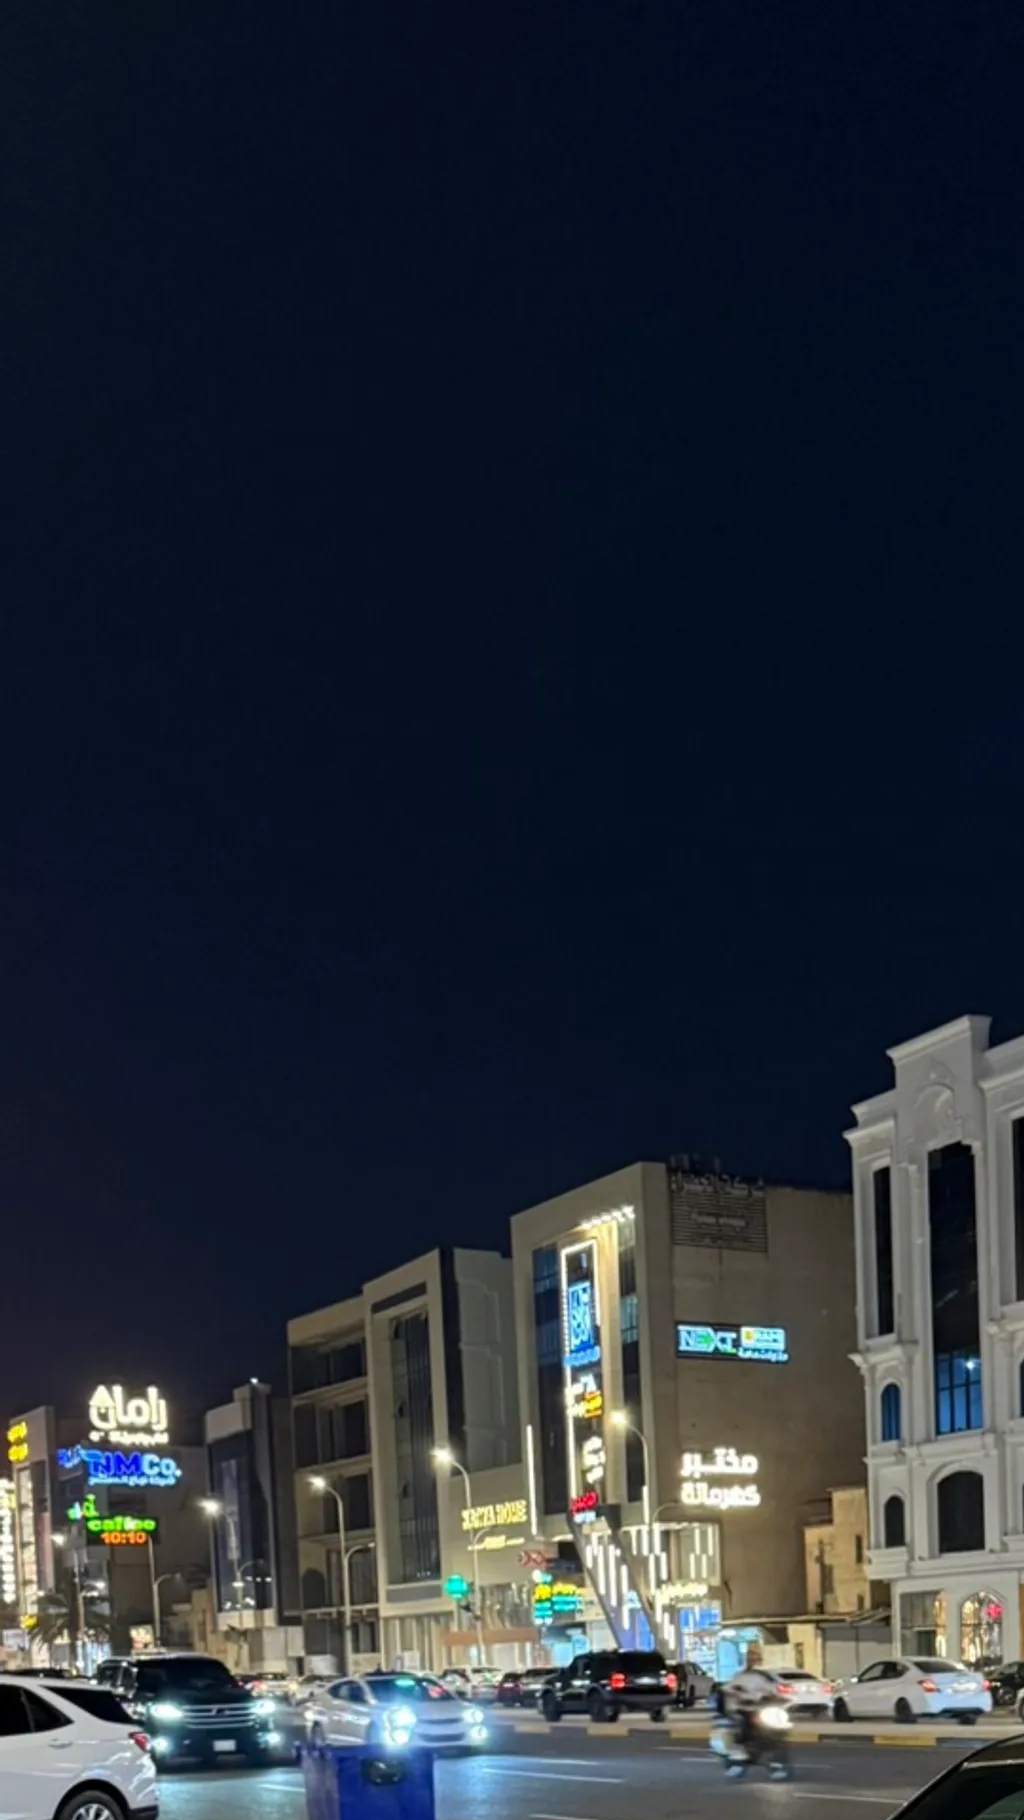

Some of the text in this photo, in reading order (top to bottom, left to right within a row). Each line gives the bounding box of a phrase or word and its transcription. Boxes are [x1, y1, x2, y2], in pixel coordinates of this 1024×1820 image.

[677, 1325, 737, 1353] NEXT
[88, 1451, 182, 1477] NMCo.
[680, 1446, 759, 1478] مختبر
[100, 1531, 147, 1544] 10:10
